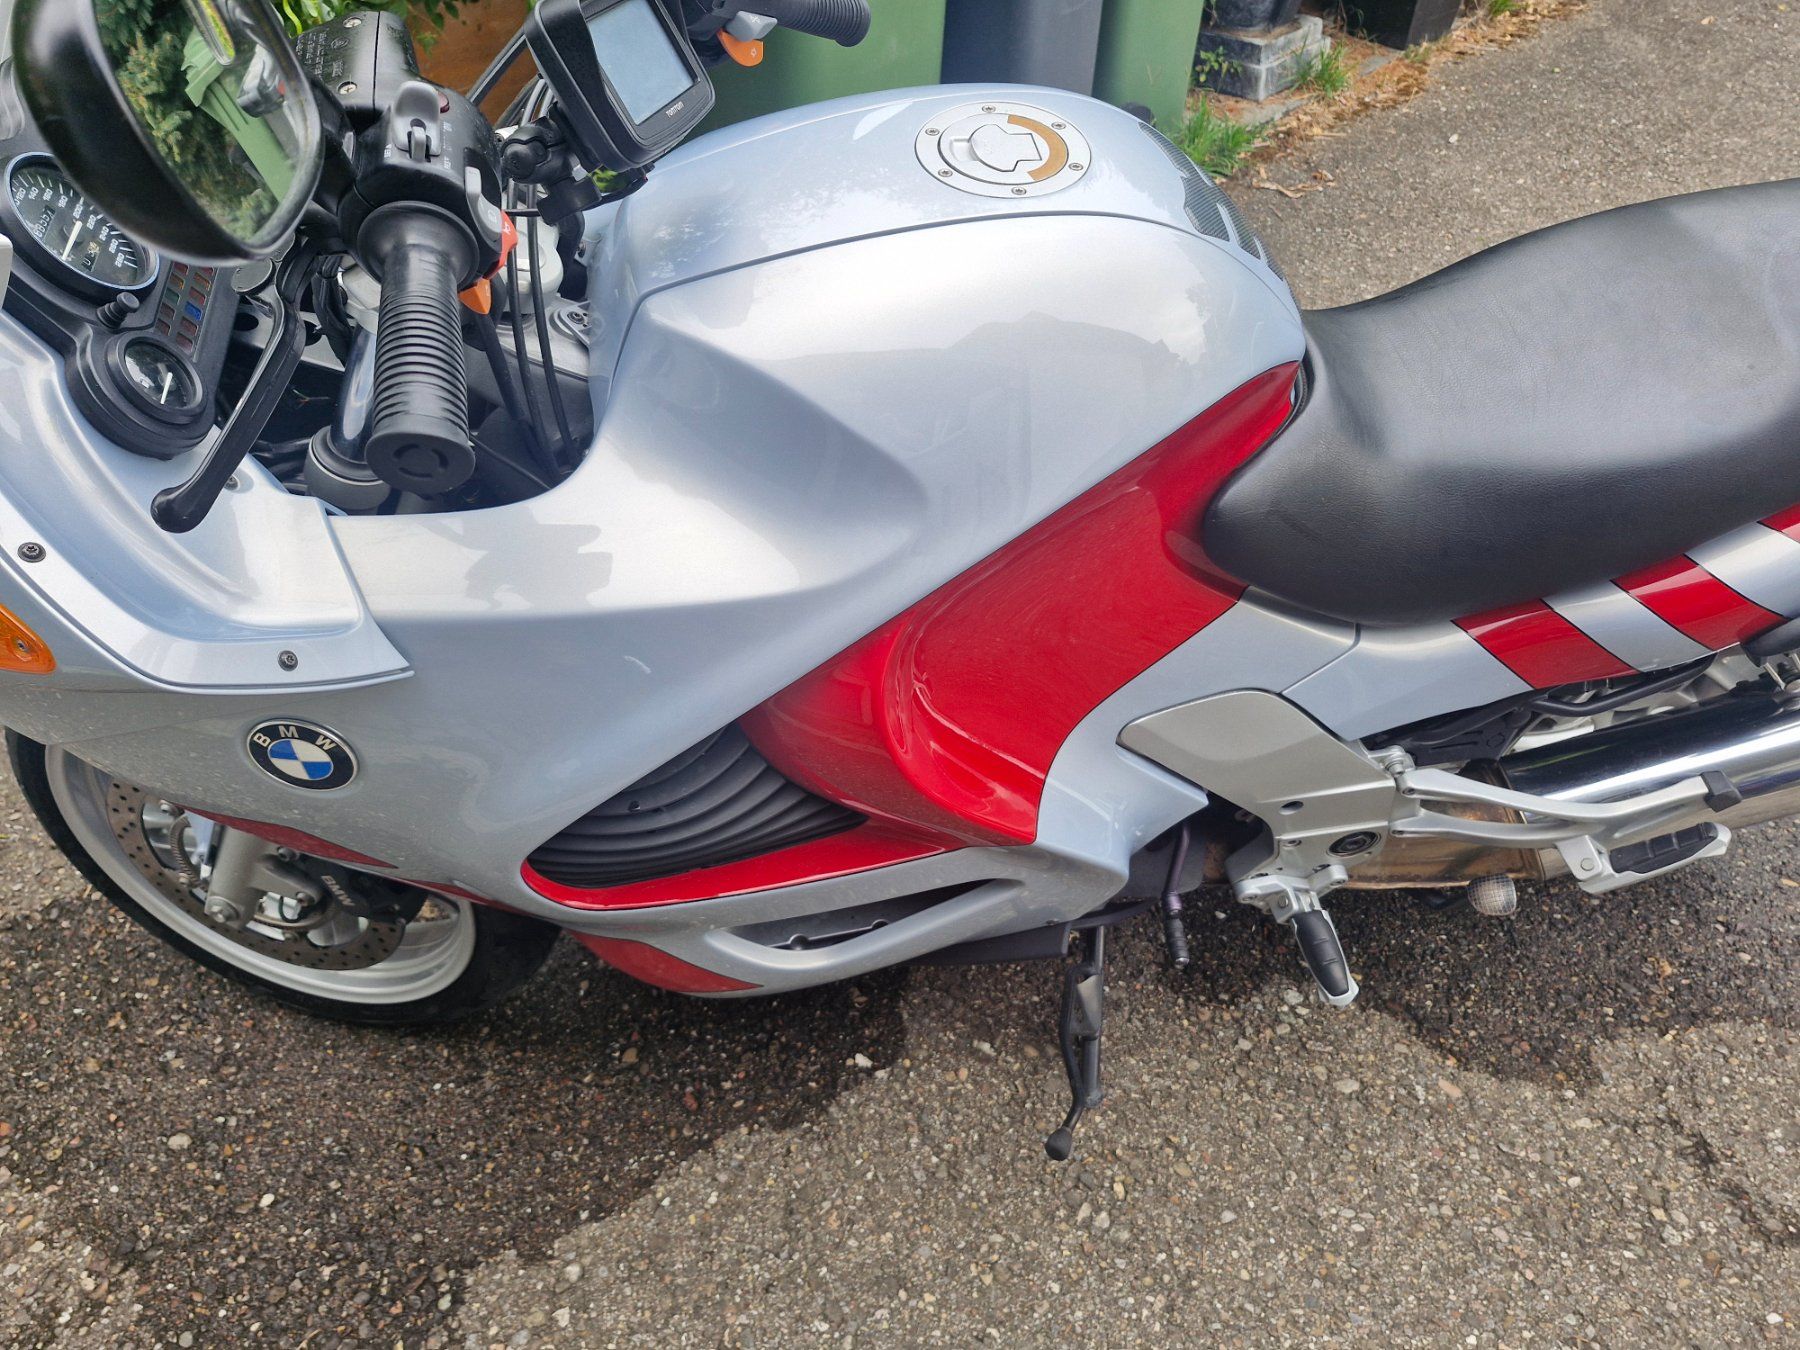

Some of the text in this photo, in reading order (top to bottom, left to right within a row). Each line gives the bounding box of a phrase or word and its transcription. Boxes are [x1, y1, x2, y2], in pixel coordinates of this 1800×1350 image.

[28, 186, 39, 200] 140
[42, 188, 54, 202] 160
[58, 195, 68, 208] 180
[72, 204, 84, 219] 200
[86, 214, 97, 230] 220
[99, 226, 110, 241] 240
[253, 726, 337, 750] BMW
[320, 876, 354, 906] BMW
